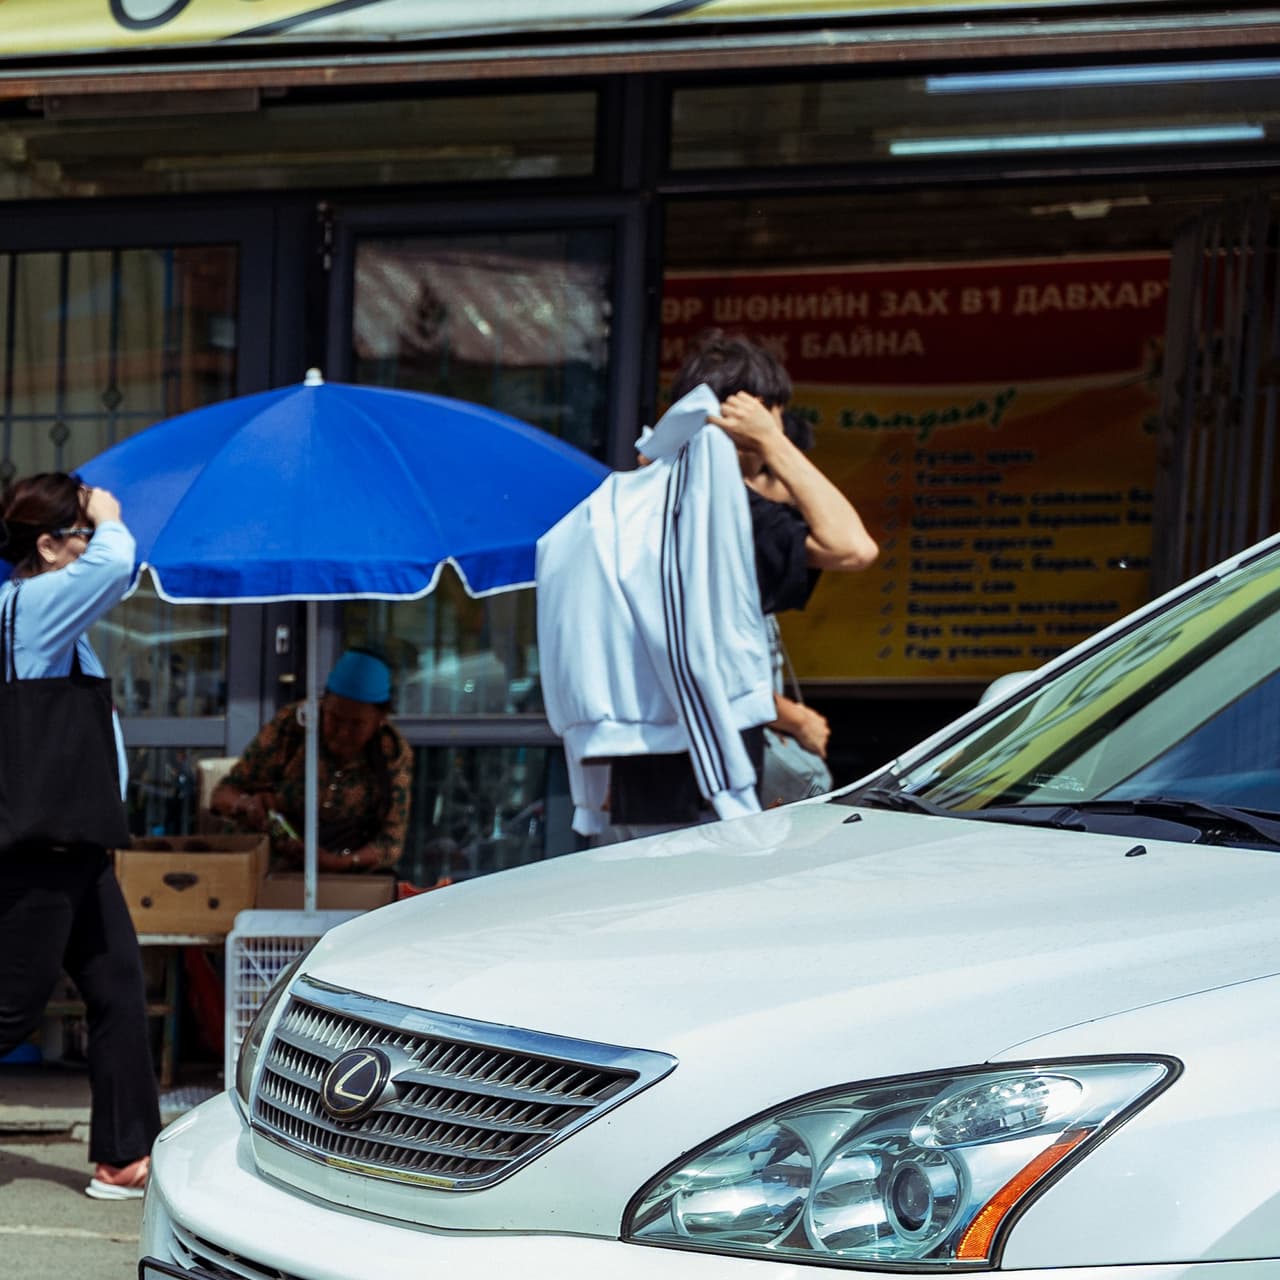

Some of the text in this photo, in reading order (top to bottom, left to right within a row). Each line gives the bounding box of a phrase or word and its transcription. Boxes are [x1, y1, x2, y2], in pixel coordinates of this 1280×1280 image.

[713, 286, 870, 322] ШӨНИЙН
[878, 289, 949, 318] ЗАХ
[1013, 280, 1170, 316] ДАВХАР
[801, 323, 926, 360] БАЙНА
